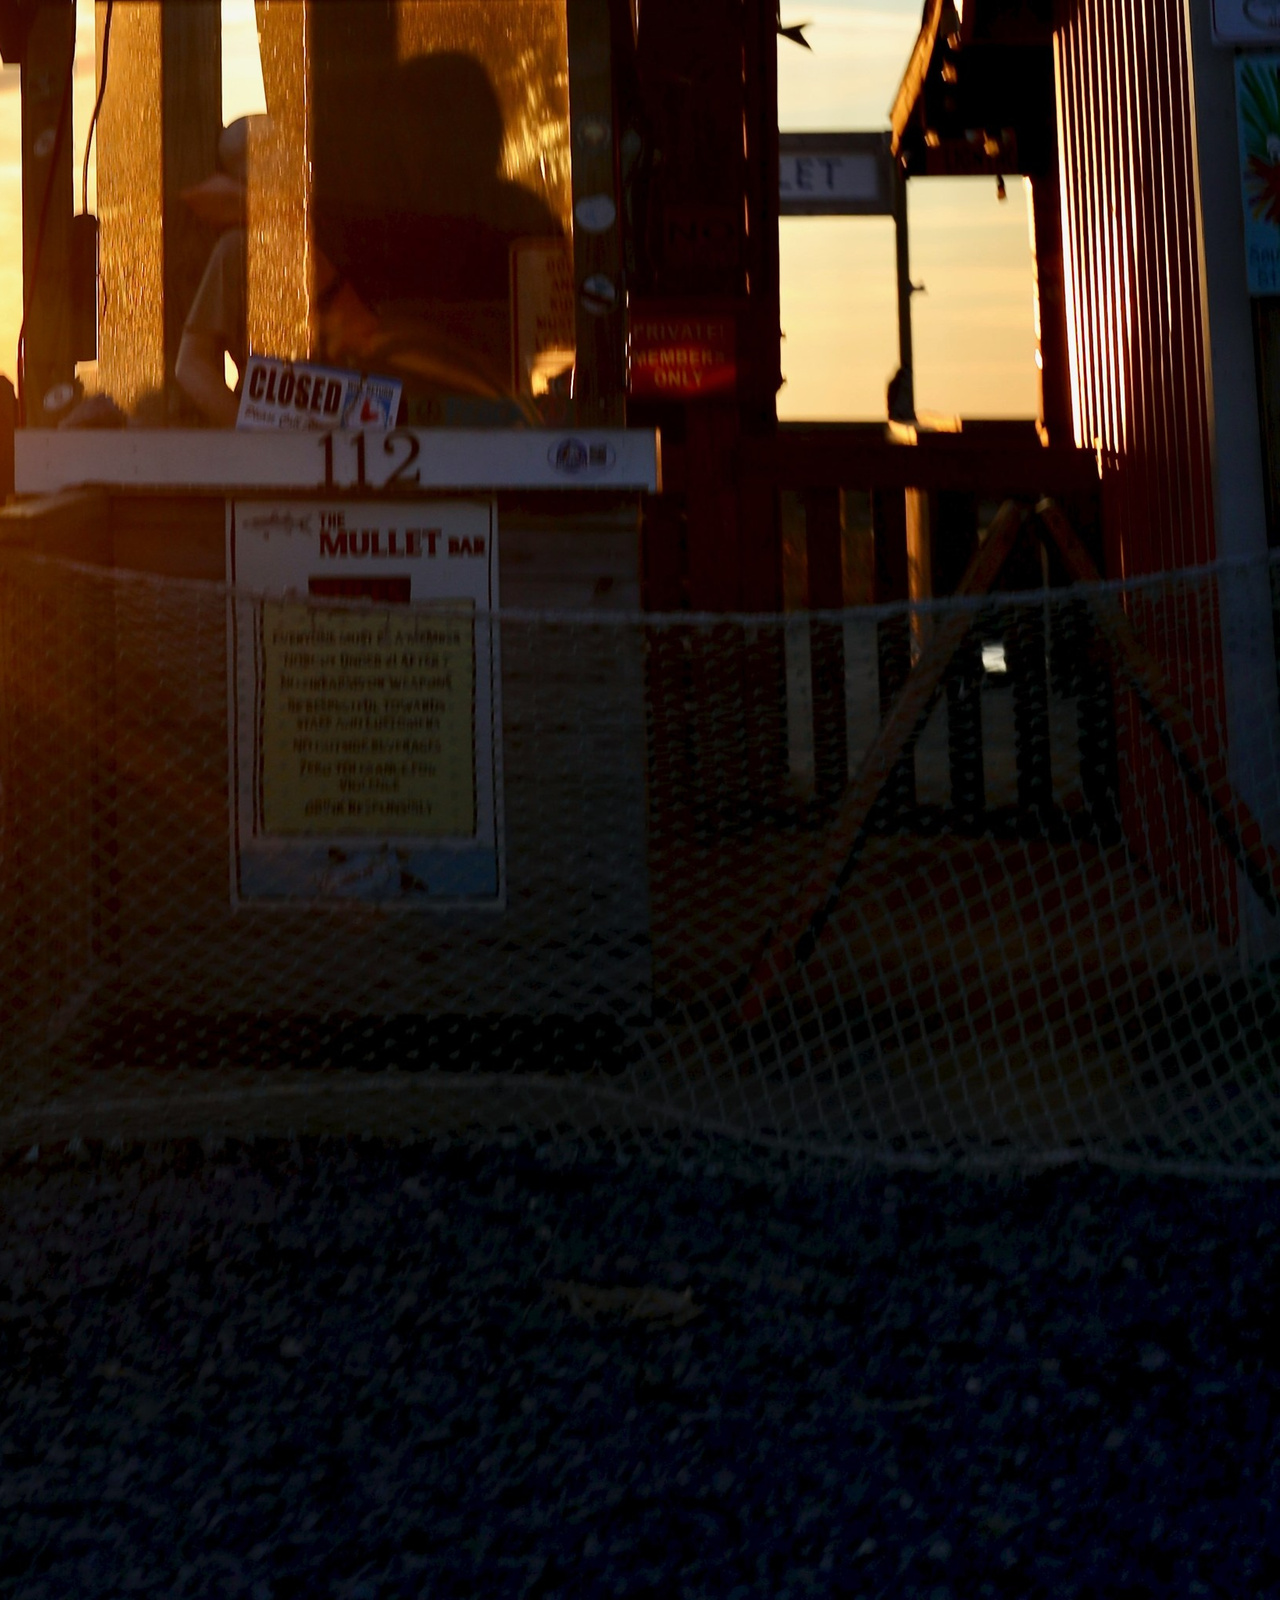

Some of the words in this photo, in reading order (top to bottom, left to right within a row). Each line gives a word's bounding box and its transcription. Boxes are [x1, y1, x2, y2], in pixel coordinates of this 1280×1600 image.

[633, 349, 725, 368] MEMBERS
[249, 364, 342, 416] CLOSED
[653, 368, 703, 388] ONLY
[318, 431, 421, 488] 112
[320, 511, 345, 529] THE
[320, 529, 442, 558] MULLET
[448, 535, 485, 557] BAR
